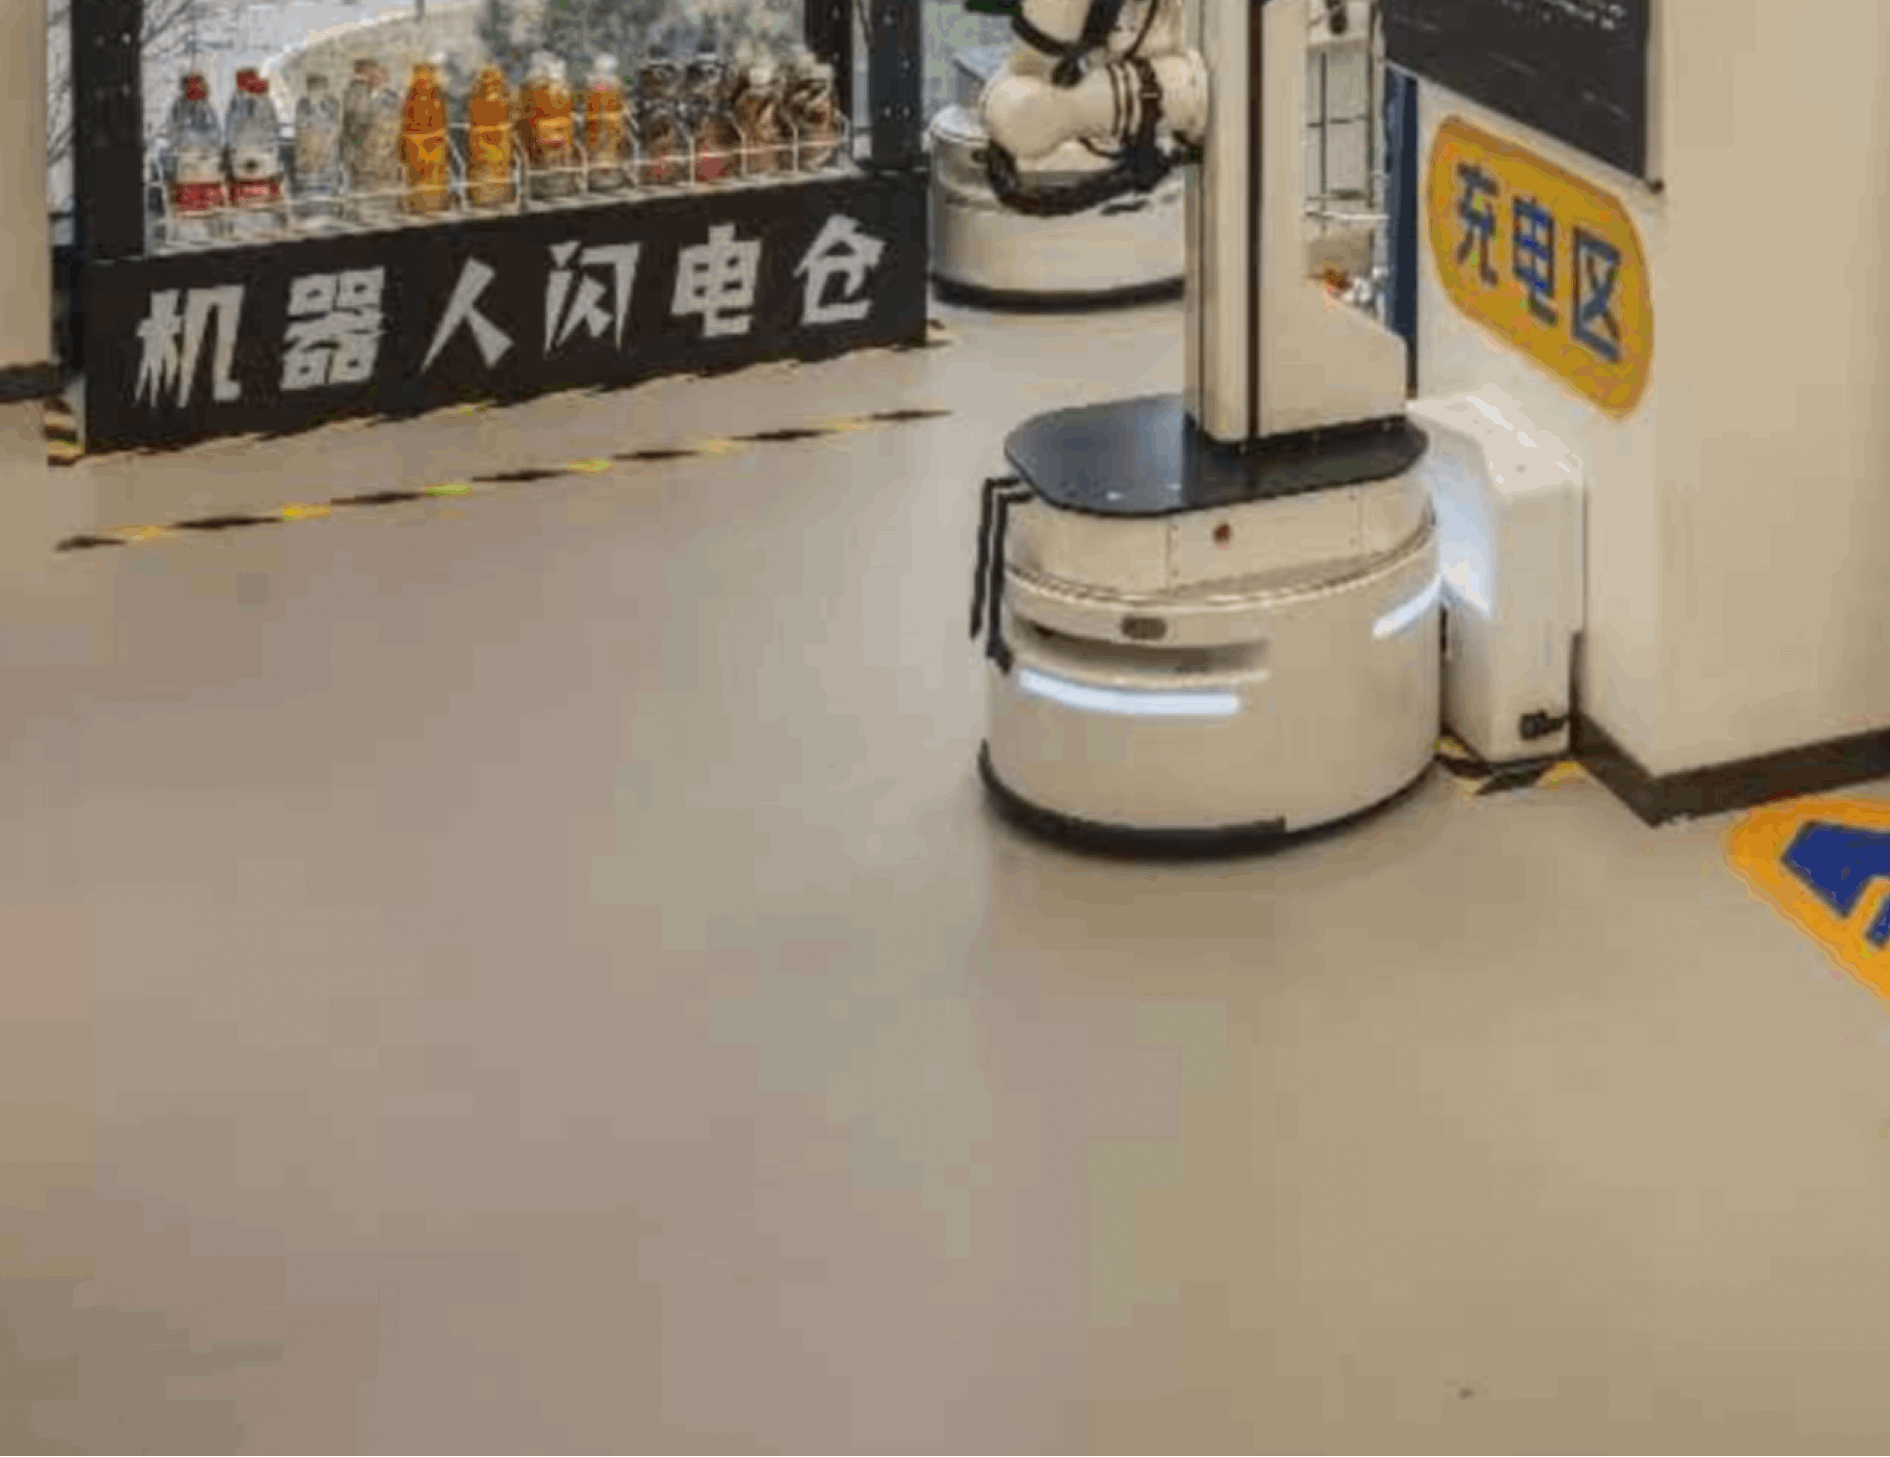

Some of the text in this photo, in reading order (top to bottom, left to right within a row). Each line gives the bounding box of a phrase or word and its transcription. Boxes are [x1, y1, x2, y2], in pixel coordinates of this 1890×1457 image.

[131, 213, 887, 409] 机器人闪电仓
[1454, 162, 1622, 364] 充电区
